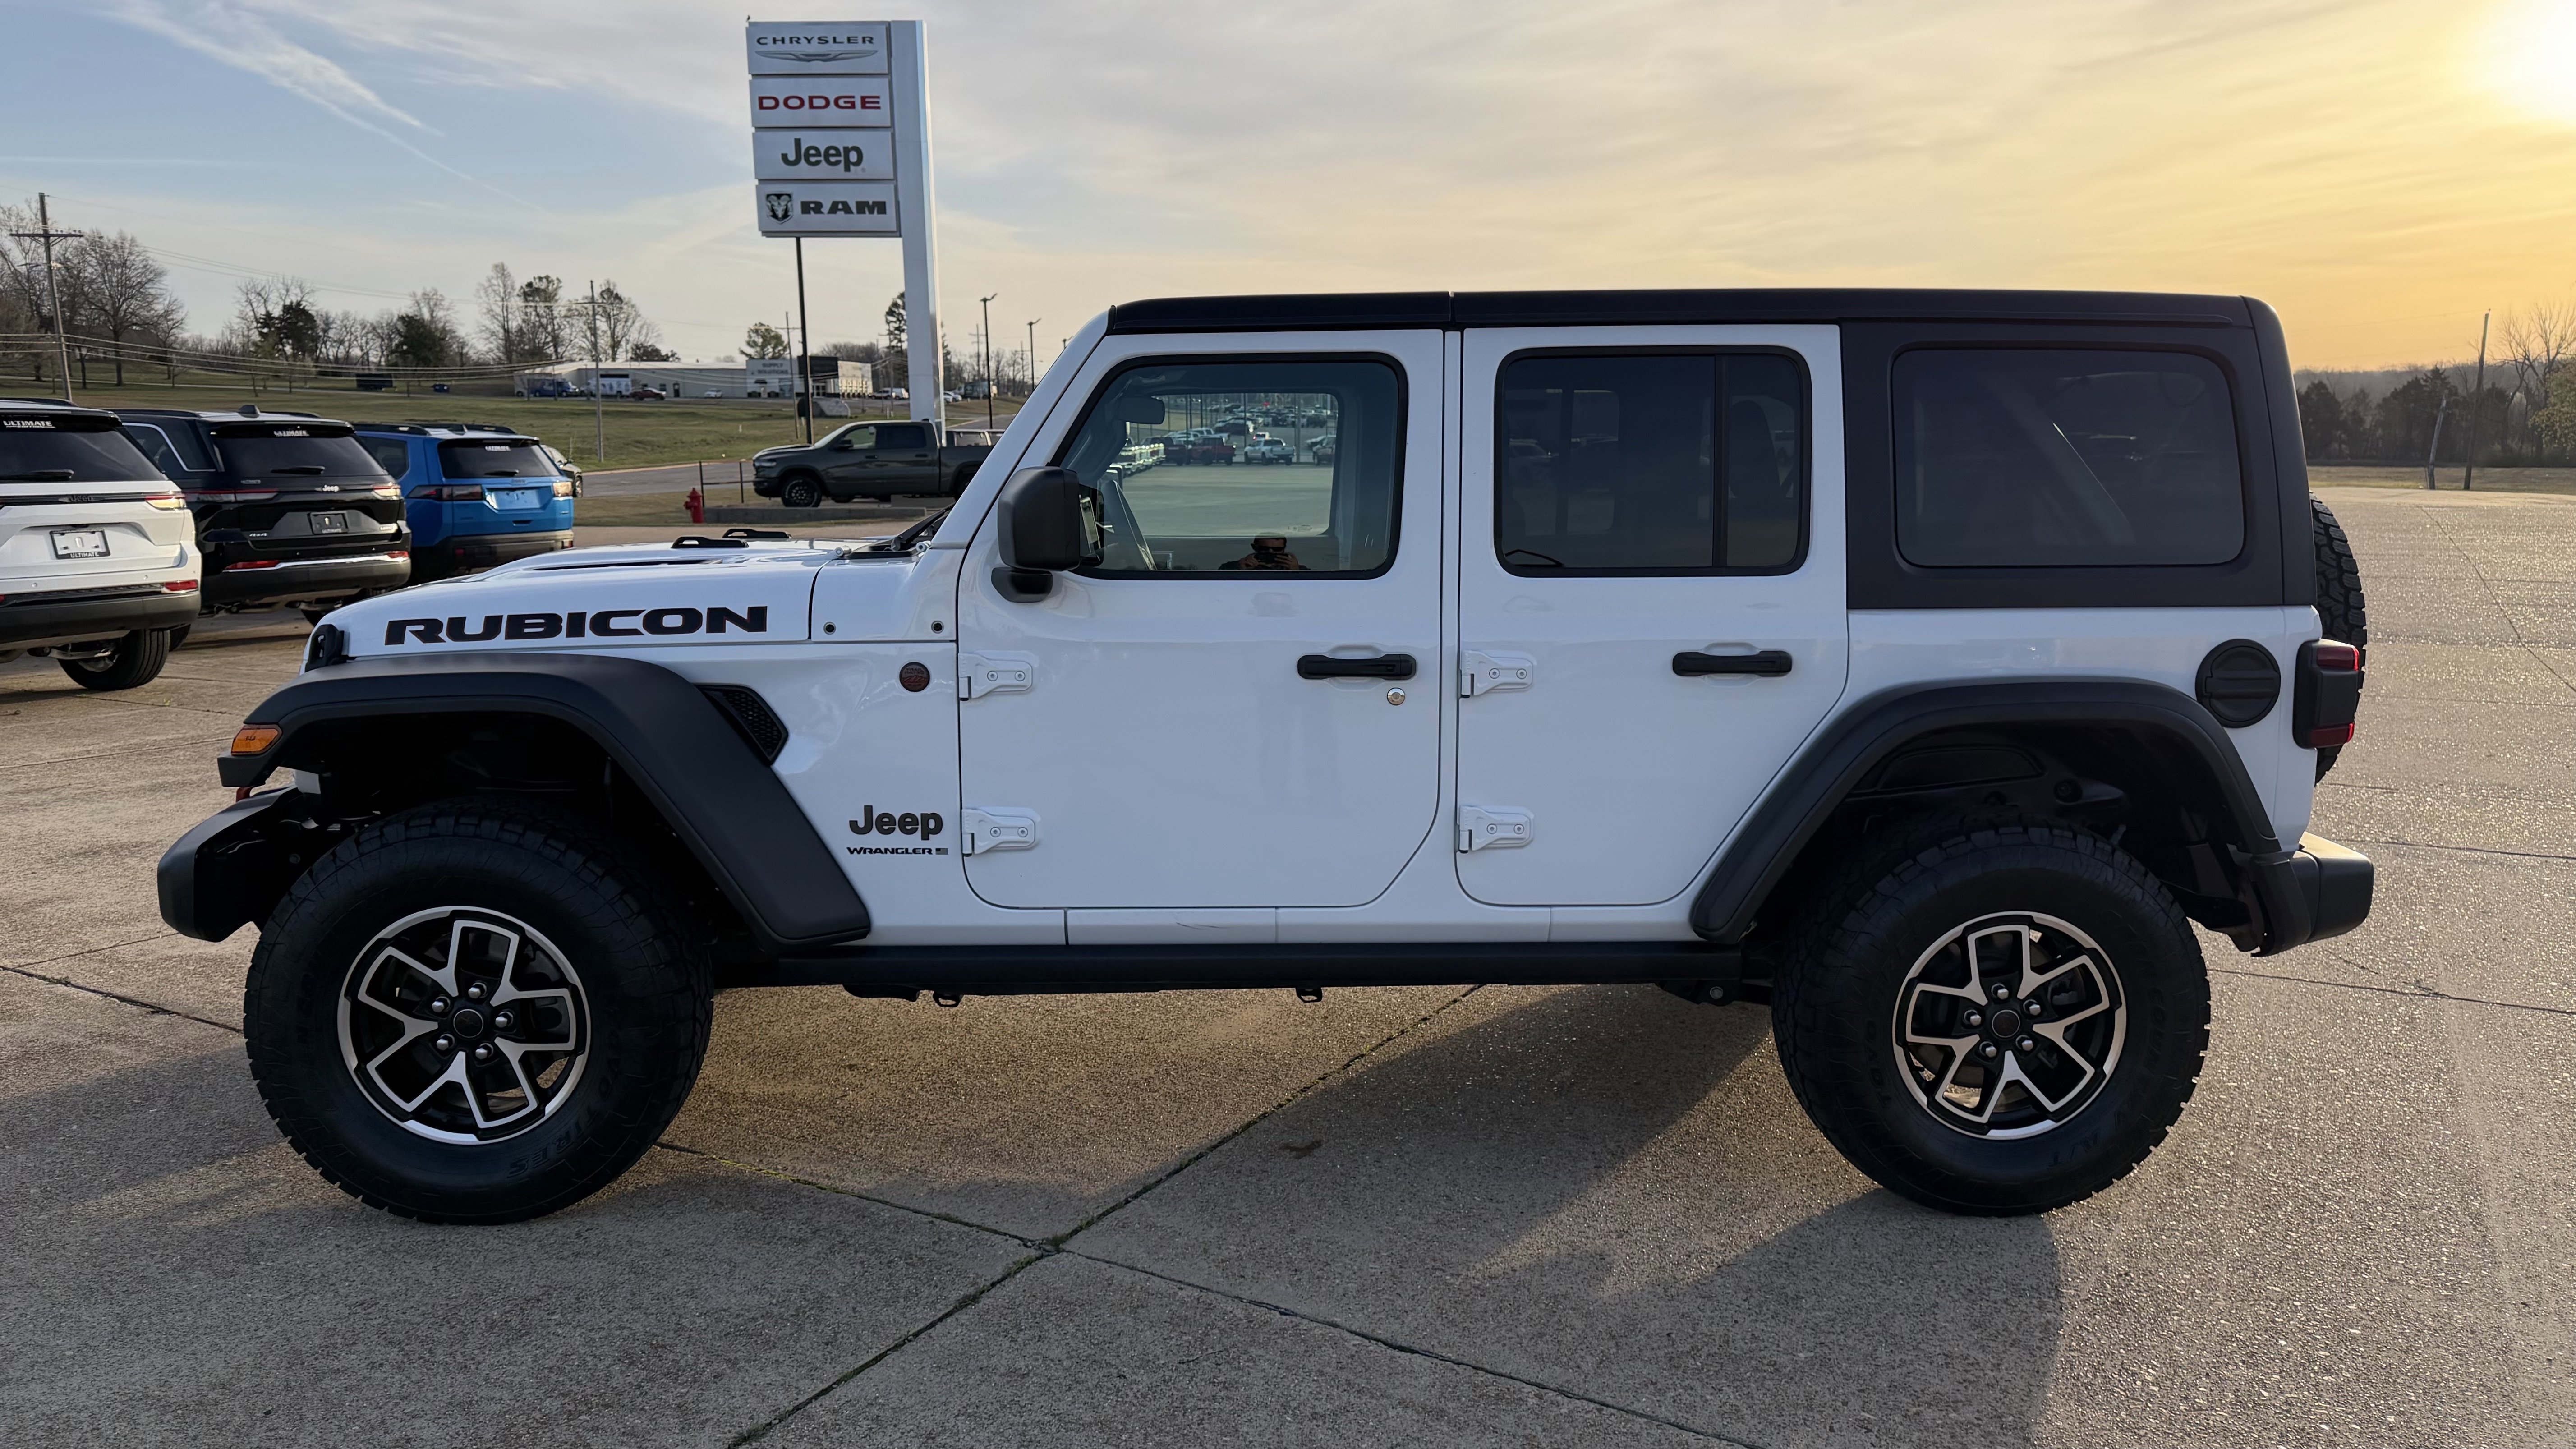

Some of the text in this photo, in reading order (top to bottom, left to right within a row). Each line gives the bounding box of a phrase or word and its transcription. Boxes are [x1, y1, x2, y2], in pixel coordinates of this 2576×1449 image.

[756, 36, 874, 46] CHRYSLER
[758, 95, 881, 110] DODGE
[780, 138, 864, 172] Jeep
[800, 200, 887, 215] RAM
[385, 606, 768, 646] RUBICON
[849, 805, 943, 841] Jeep
[846, 846, 933, 855] WRANGLER
